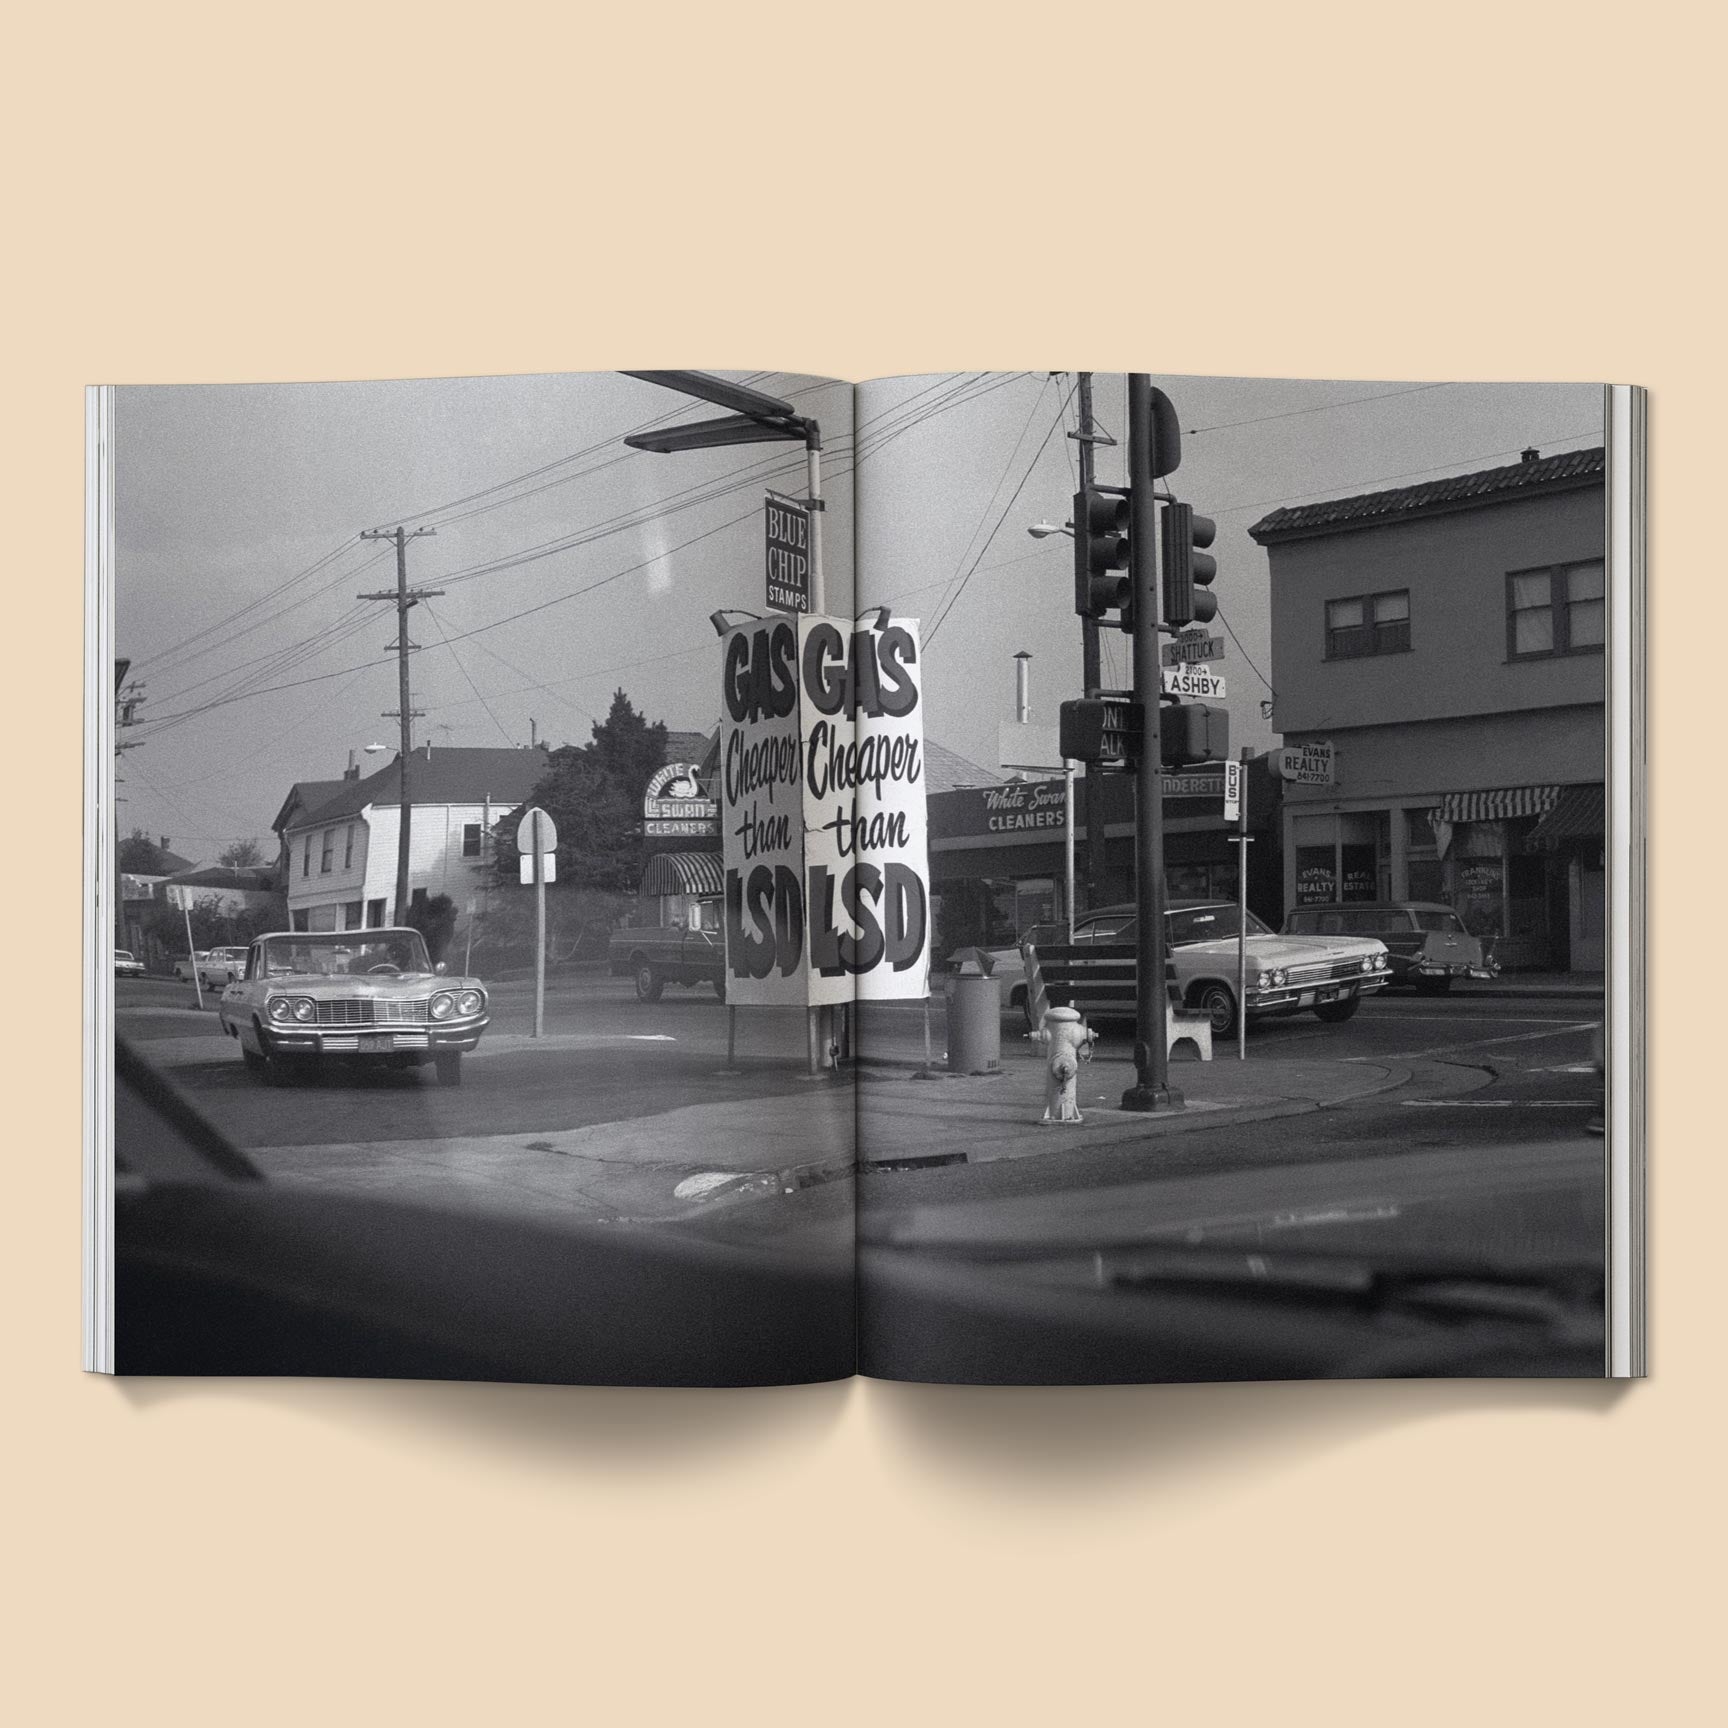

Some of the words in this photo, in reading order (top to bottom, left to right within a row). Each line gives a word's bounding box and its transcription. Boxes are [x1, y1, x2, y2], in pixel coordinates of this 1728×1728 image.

[769, 506, 807, 549] BLUE
[769, 546, 806, 587] CHIP
[769, 585, 807, 610] STAMPS
[1171, 640, 1215, 662] SHATTUCK
[725, 623, 796, 724] GAS
[803, 623, 919, 721] GAS
[1171, 675, 1220, 695] ASHBY
[807, 720, 921, 801] Cheaper
[1101, 733, 1126, 756] ALK
[1302, 747, 1331, 758] EVANS
[647, 763, 684, 797] WHITE
[726, 728, 798, 807] Cheaper
[1228, 764, 1238, 798] BUS
[1285, 756, 1329, 773] REALTY
[982, 786, 1028, 810] White
[646, 822, 715, 834] CLEANERS
[735, 801, 792, 859] than
[823, 798, 910, 858] than
[988, 810, 1065, 831] CLEANERS
[1297, 881, 1335, 893] REALTY
[1302, 867, 1332, 879] EVANS
[726, 865, 803, 979] LSD
[809, 862, 927, 977] LSD
